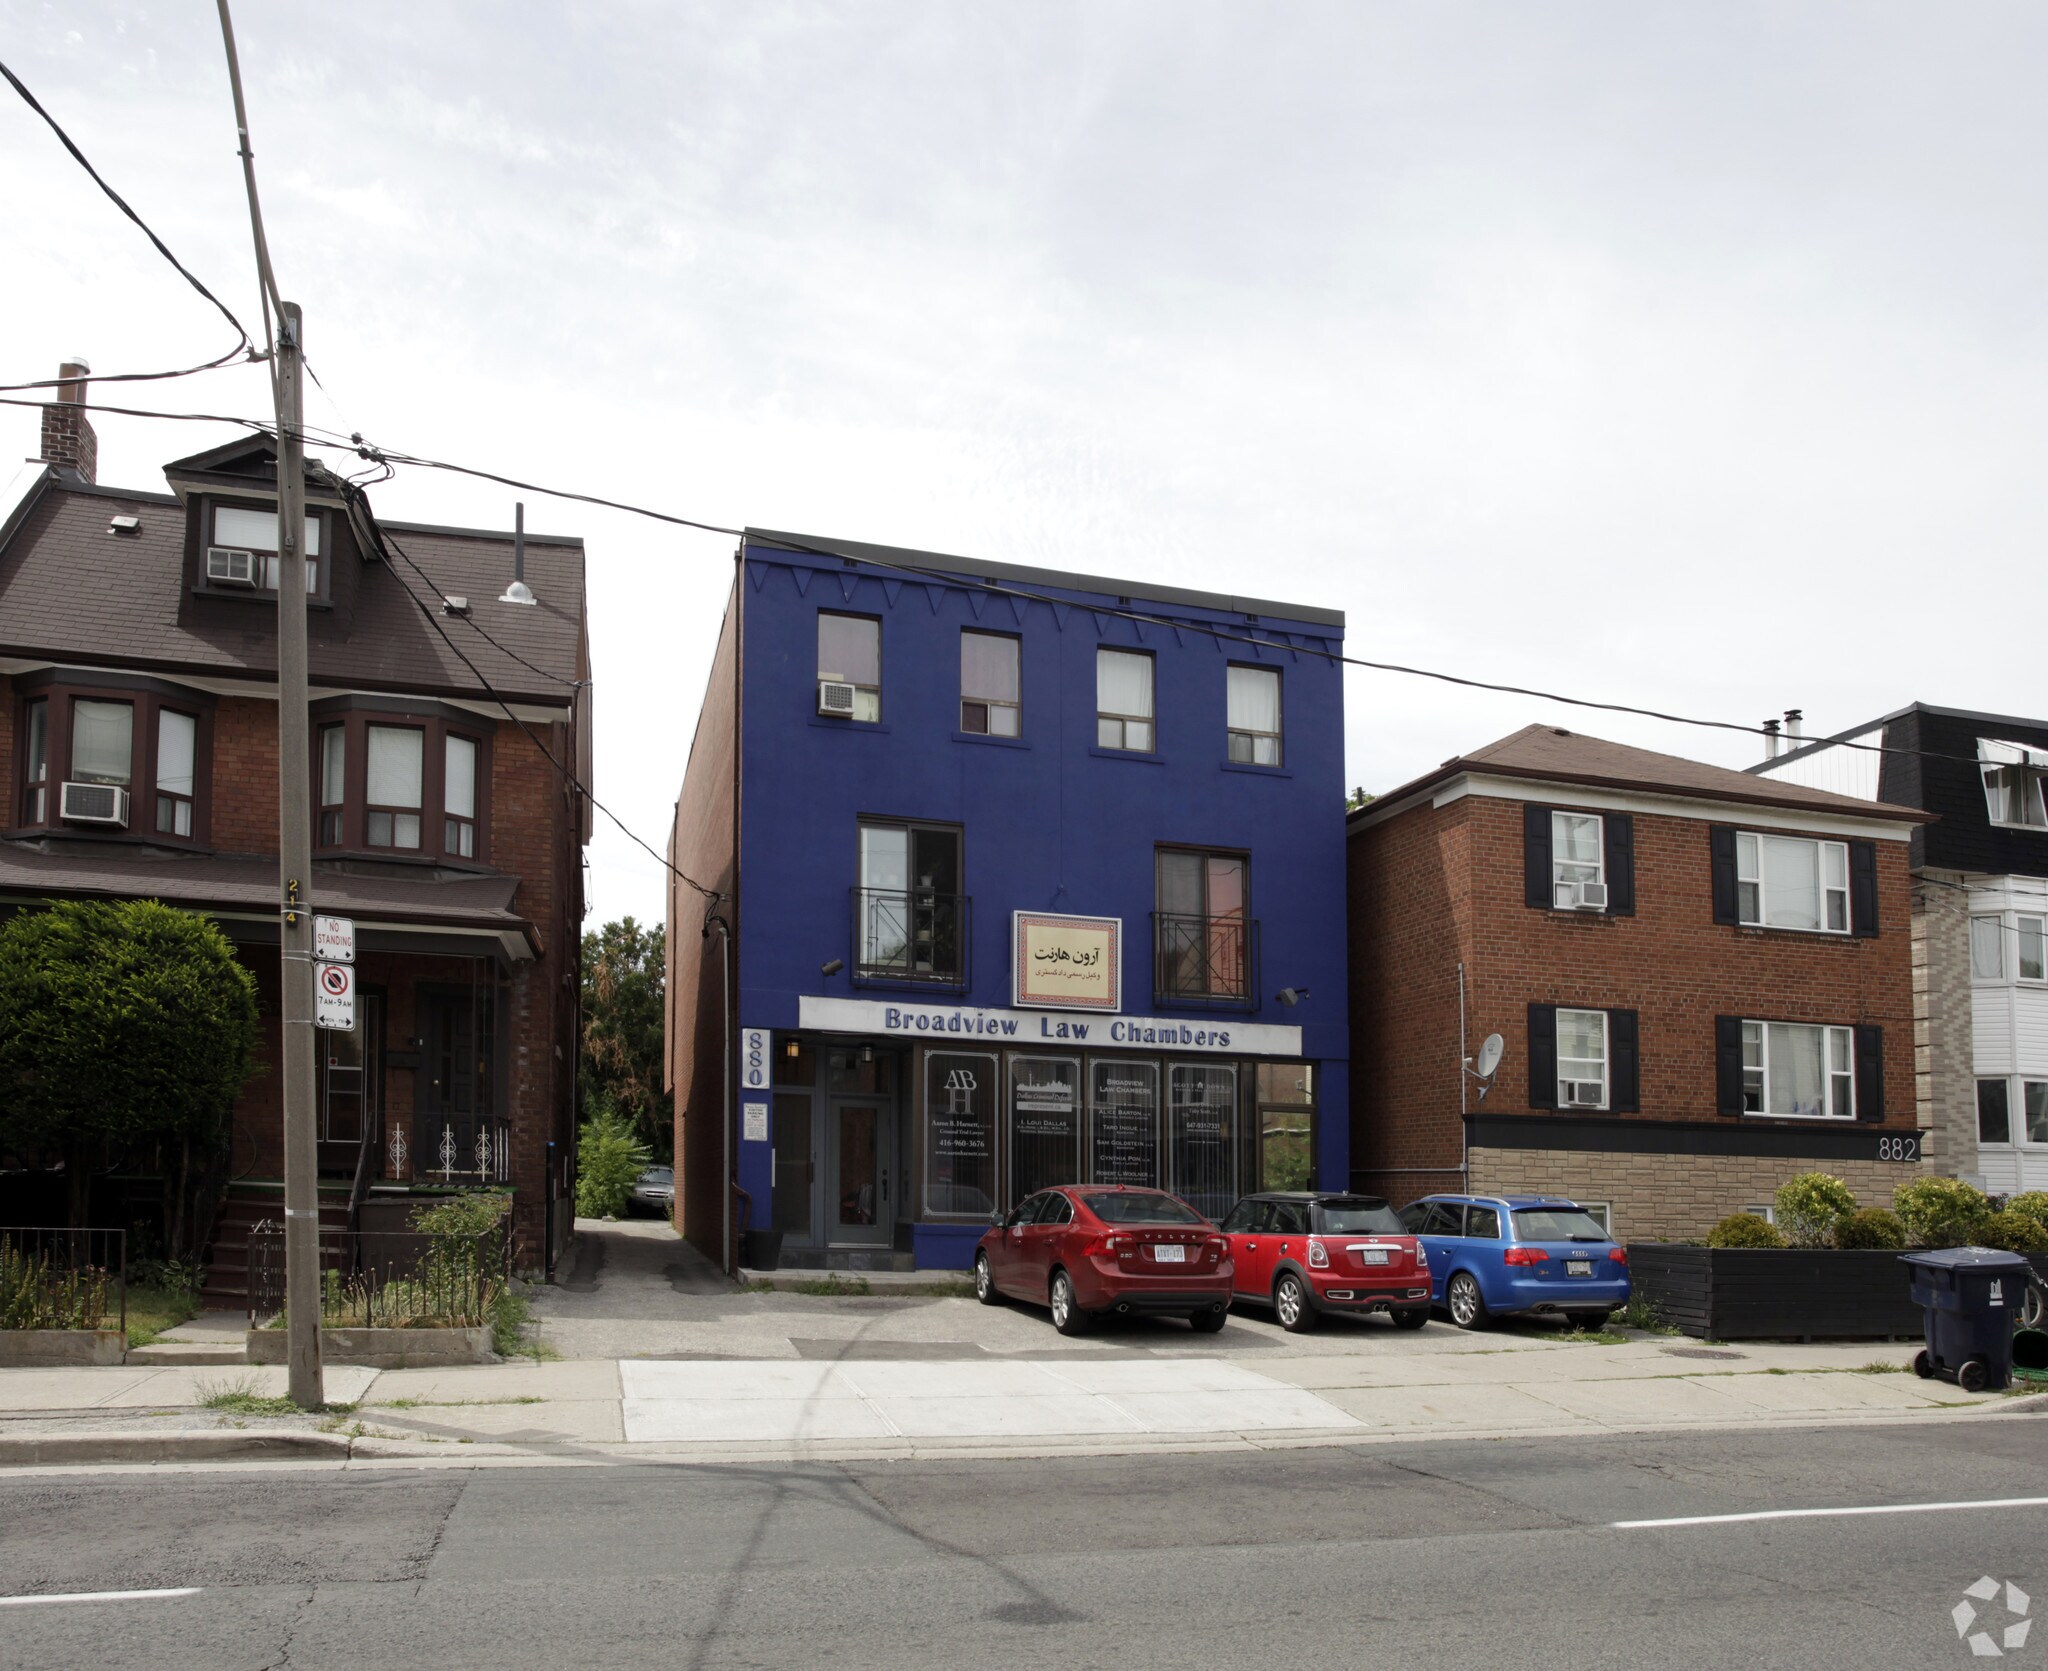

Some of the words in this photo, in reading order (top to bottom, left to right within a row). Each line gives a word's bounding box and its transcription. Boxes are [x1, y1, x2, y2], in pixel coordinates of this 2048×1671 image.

[329, 922, 340, 933] NO
[317, 933, 352, 947] STANDING
[1072, 947, 1100, 966] آرون
[885, 1007, 1018, 1035] Broadview
[1041, 1017, 1090, 1039] Law
[1110, 1022, 1231, 1047] Chambers
[749, 1032, 763, 1086] 880
[1106, 1078, 1144, 1087] BROADVIEW
[1116, 1086, 1151, 1094] CHAMBERS
[939, 1139, 985, 1148] 416-960-3676
[1110, 1139, 1144, 1147] GOLDSTEIN
[1879, 1137, 1917, 1161] 882
